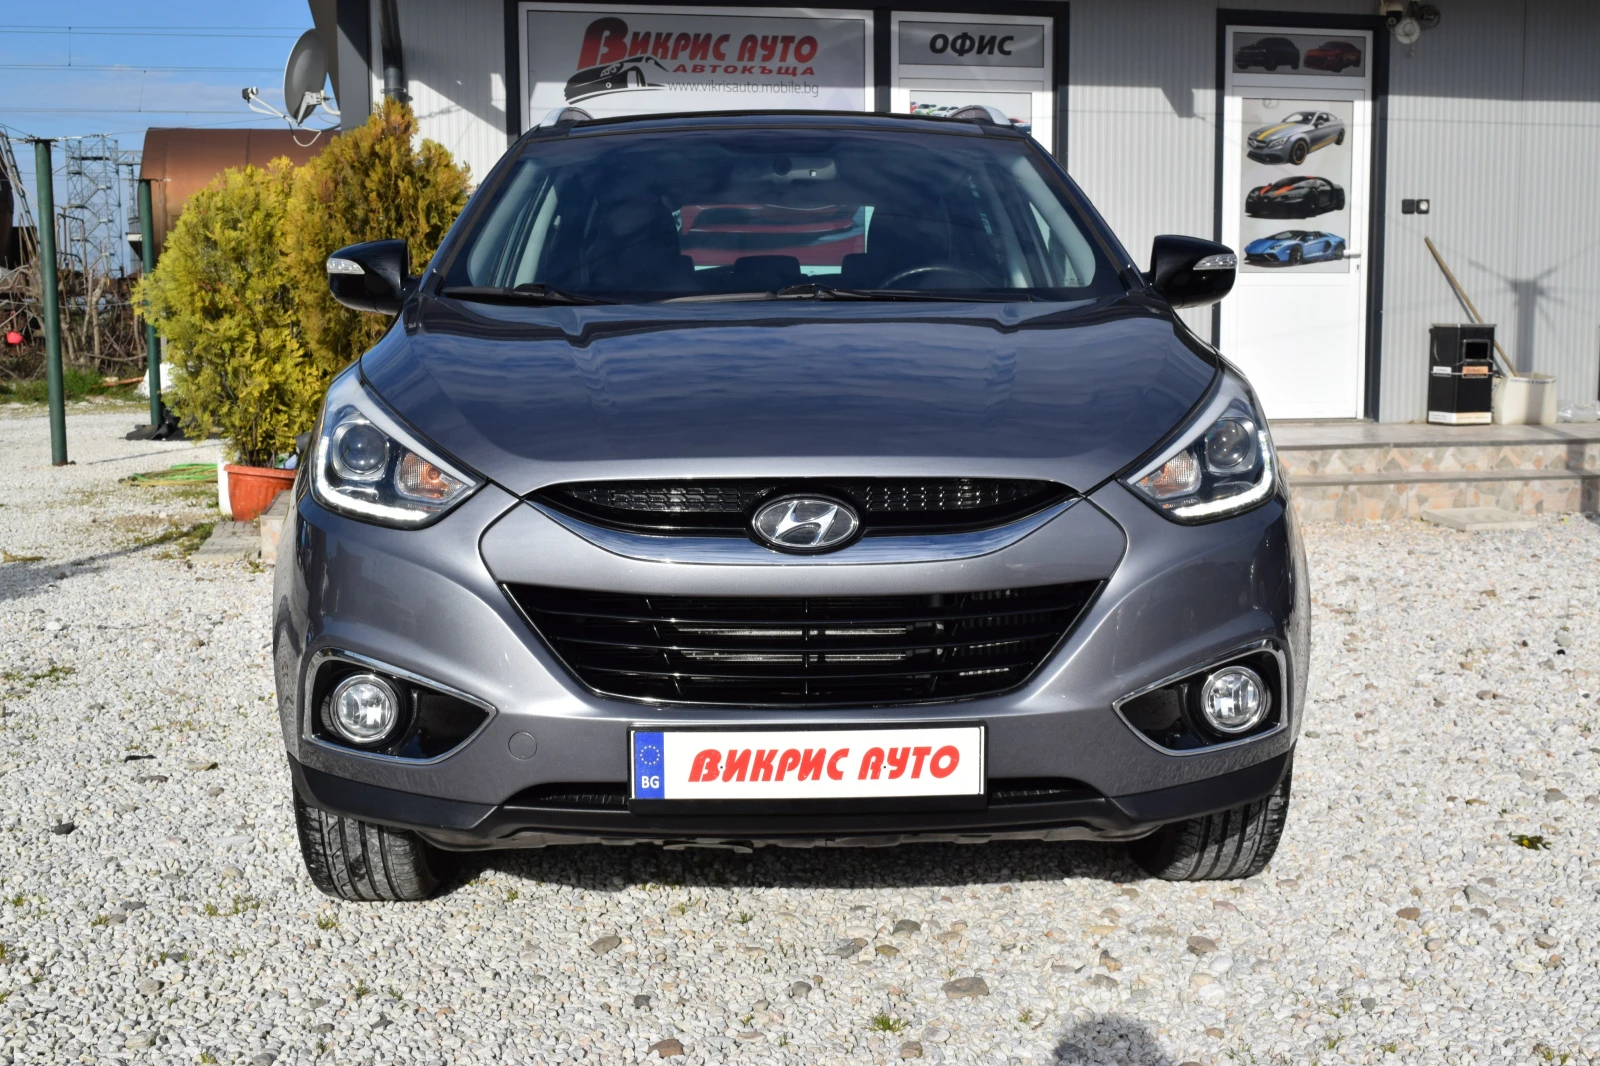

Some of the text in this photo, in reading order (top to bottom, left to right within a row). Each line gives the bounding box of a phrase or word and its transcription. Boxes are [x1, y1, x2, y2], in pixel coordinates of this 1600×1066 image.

[736, 33, 819, 64] АУТО
[929, 31, 1015, 57] ОФИС
[672, 63, 816, 78] АВТОКЪЩА
[667, 79, 820, 98] www.vikrisauto.mobile.bg
[687, 745, 960, 783] ВИКРИС АУТО
[641, 775, 660, 789] BG
